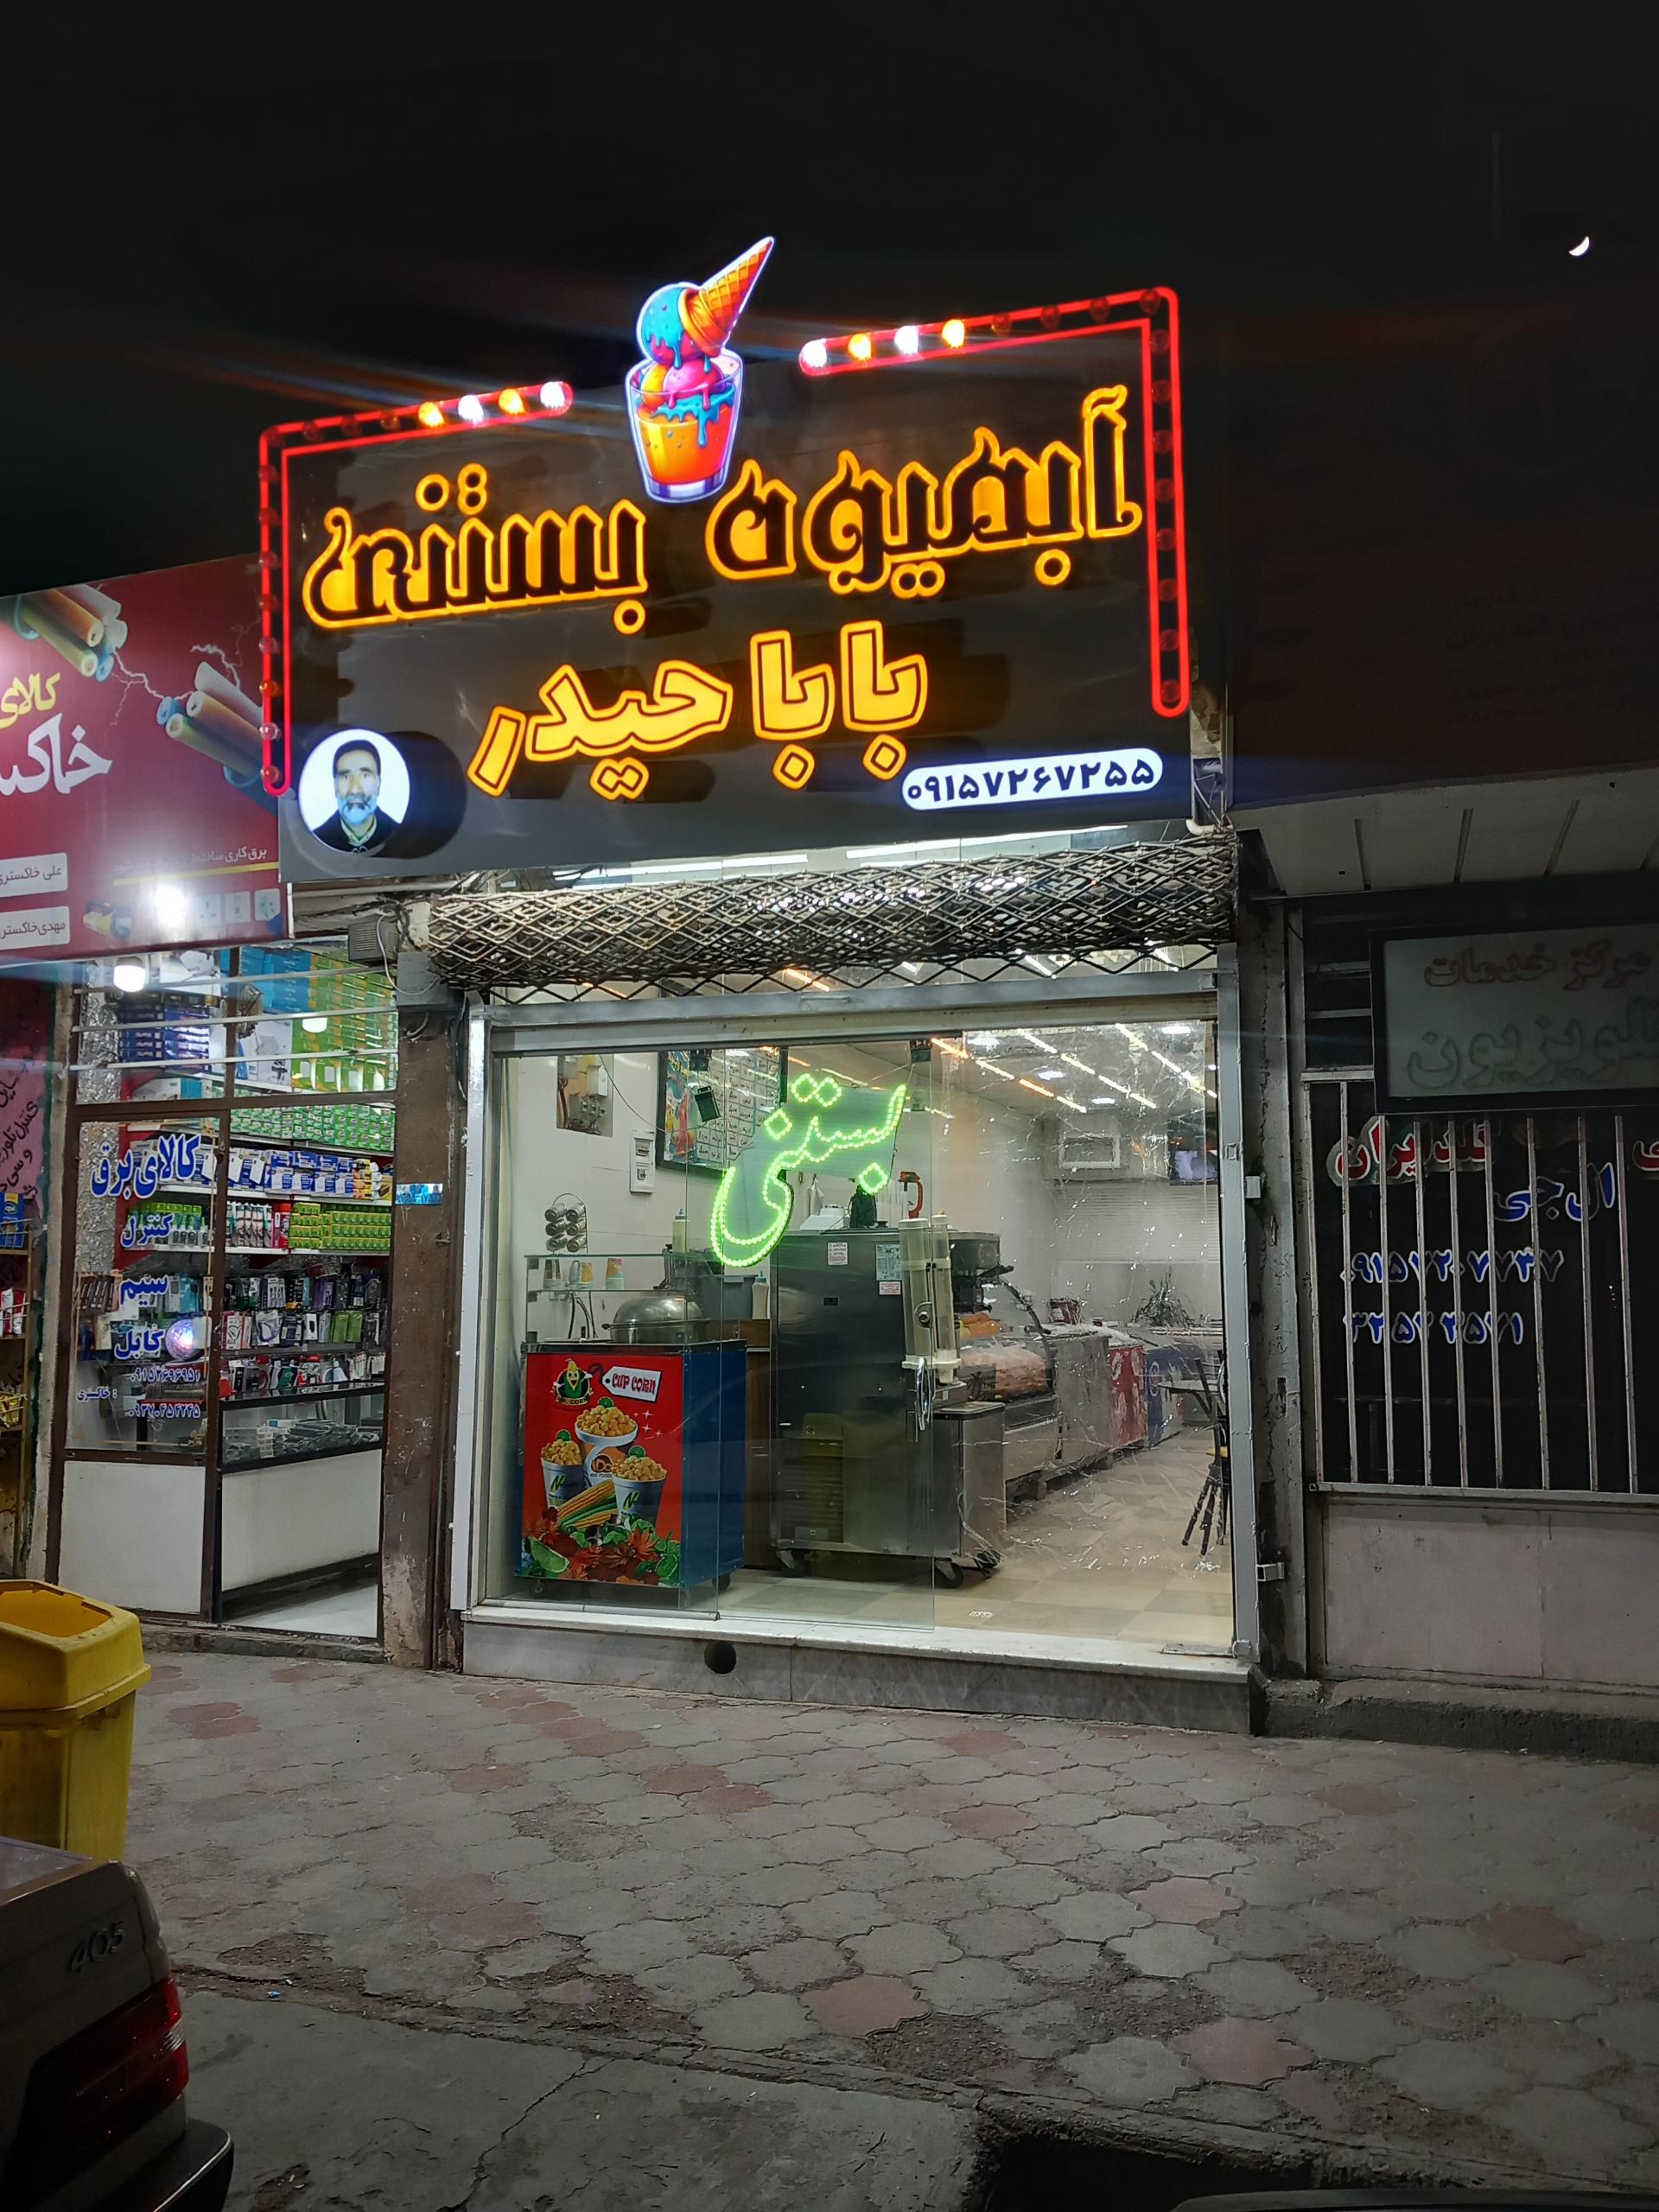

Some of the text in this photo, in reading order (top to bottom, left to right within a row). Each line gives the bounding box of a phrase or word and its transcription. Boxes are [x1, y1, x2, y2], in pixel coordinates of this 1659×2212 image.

[302, 385, 1142, 634] آبمیوه بستنی
[0, 672, 61, 728] کالای
[467, 620, 928, 801] بابا حیدر
[907, 759, 1154, 803] ۰۹۱۵۷۲۶۷۲۵۵
[42, 865, 62, 880] علی
[37, 921, 66, 936] مهدی
[1424, 943, 1558, 988] خدمات
[90, 1133, 200, 1200] کالای برق
[710, 1073, 906, 1268] بستنی
[119, 1212, 174, 1249] کنترل
[118, 1274, 170, 1308] سیم
[113, 1329, 166, 1361] کابل
[611, 1372, 631, 1389] CUP
[69, 1921, 125, 1974] 405
